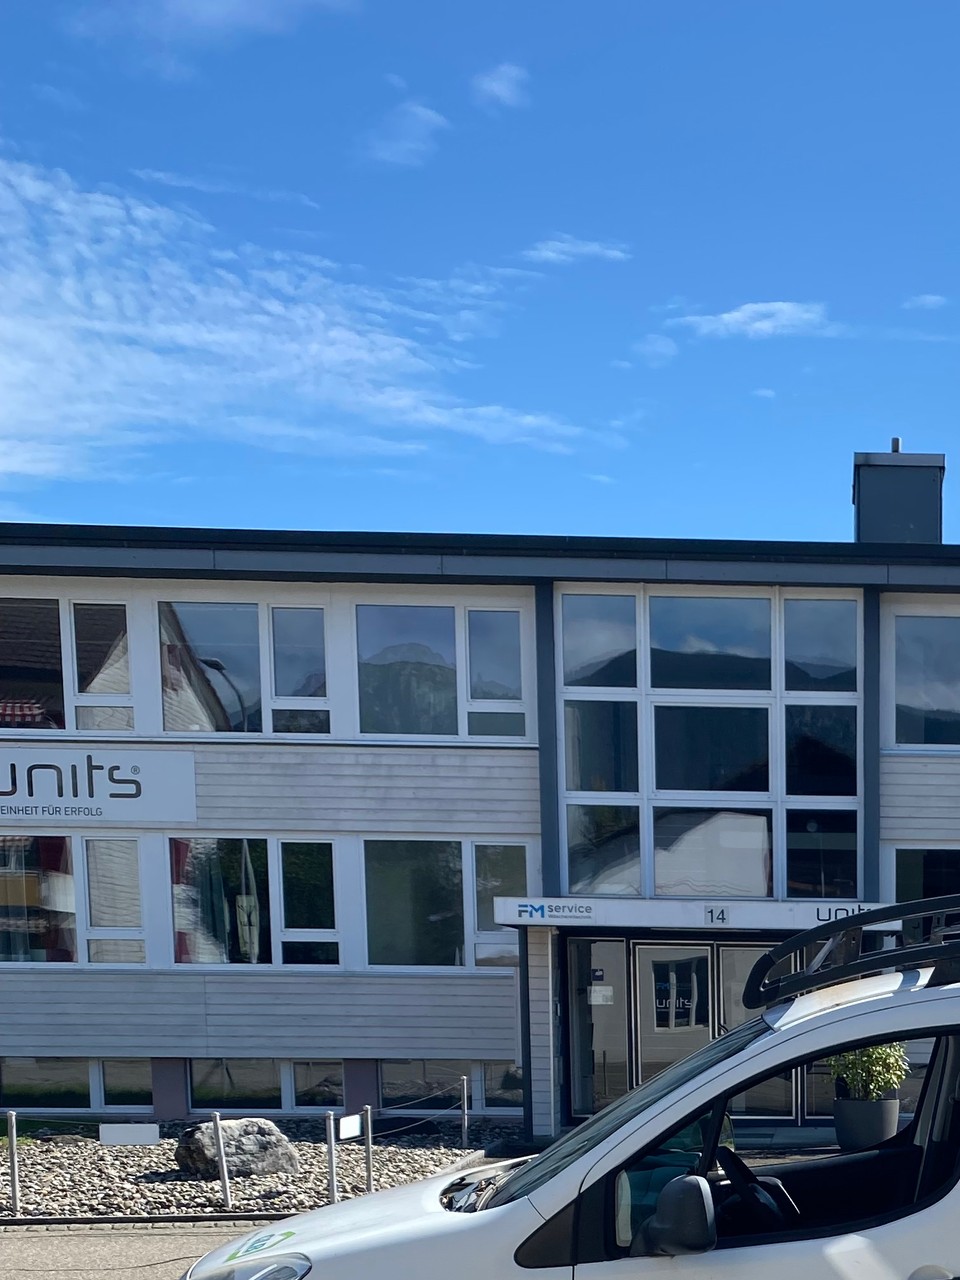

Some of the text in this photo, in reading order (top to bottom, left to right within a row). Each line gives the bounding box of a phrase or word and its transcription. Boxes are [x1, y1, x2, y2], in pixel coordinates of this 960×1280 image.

[0, 804, 103, 816] EINHEIT FÜR ERFOLG
[518, 903, 592, 918] FM service
[707, 909, 727, 923] 14
[817, 904, 872, 922] unit
